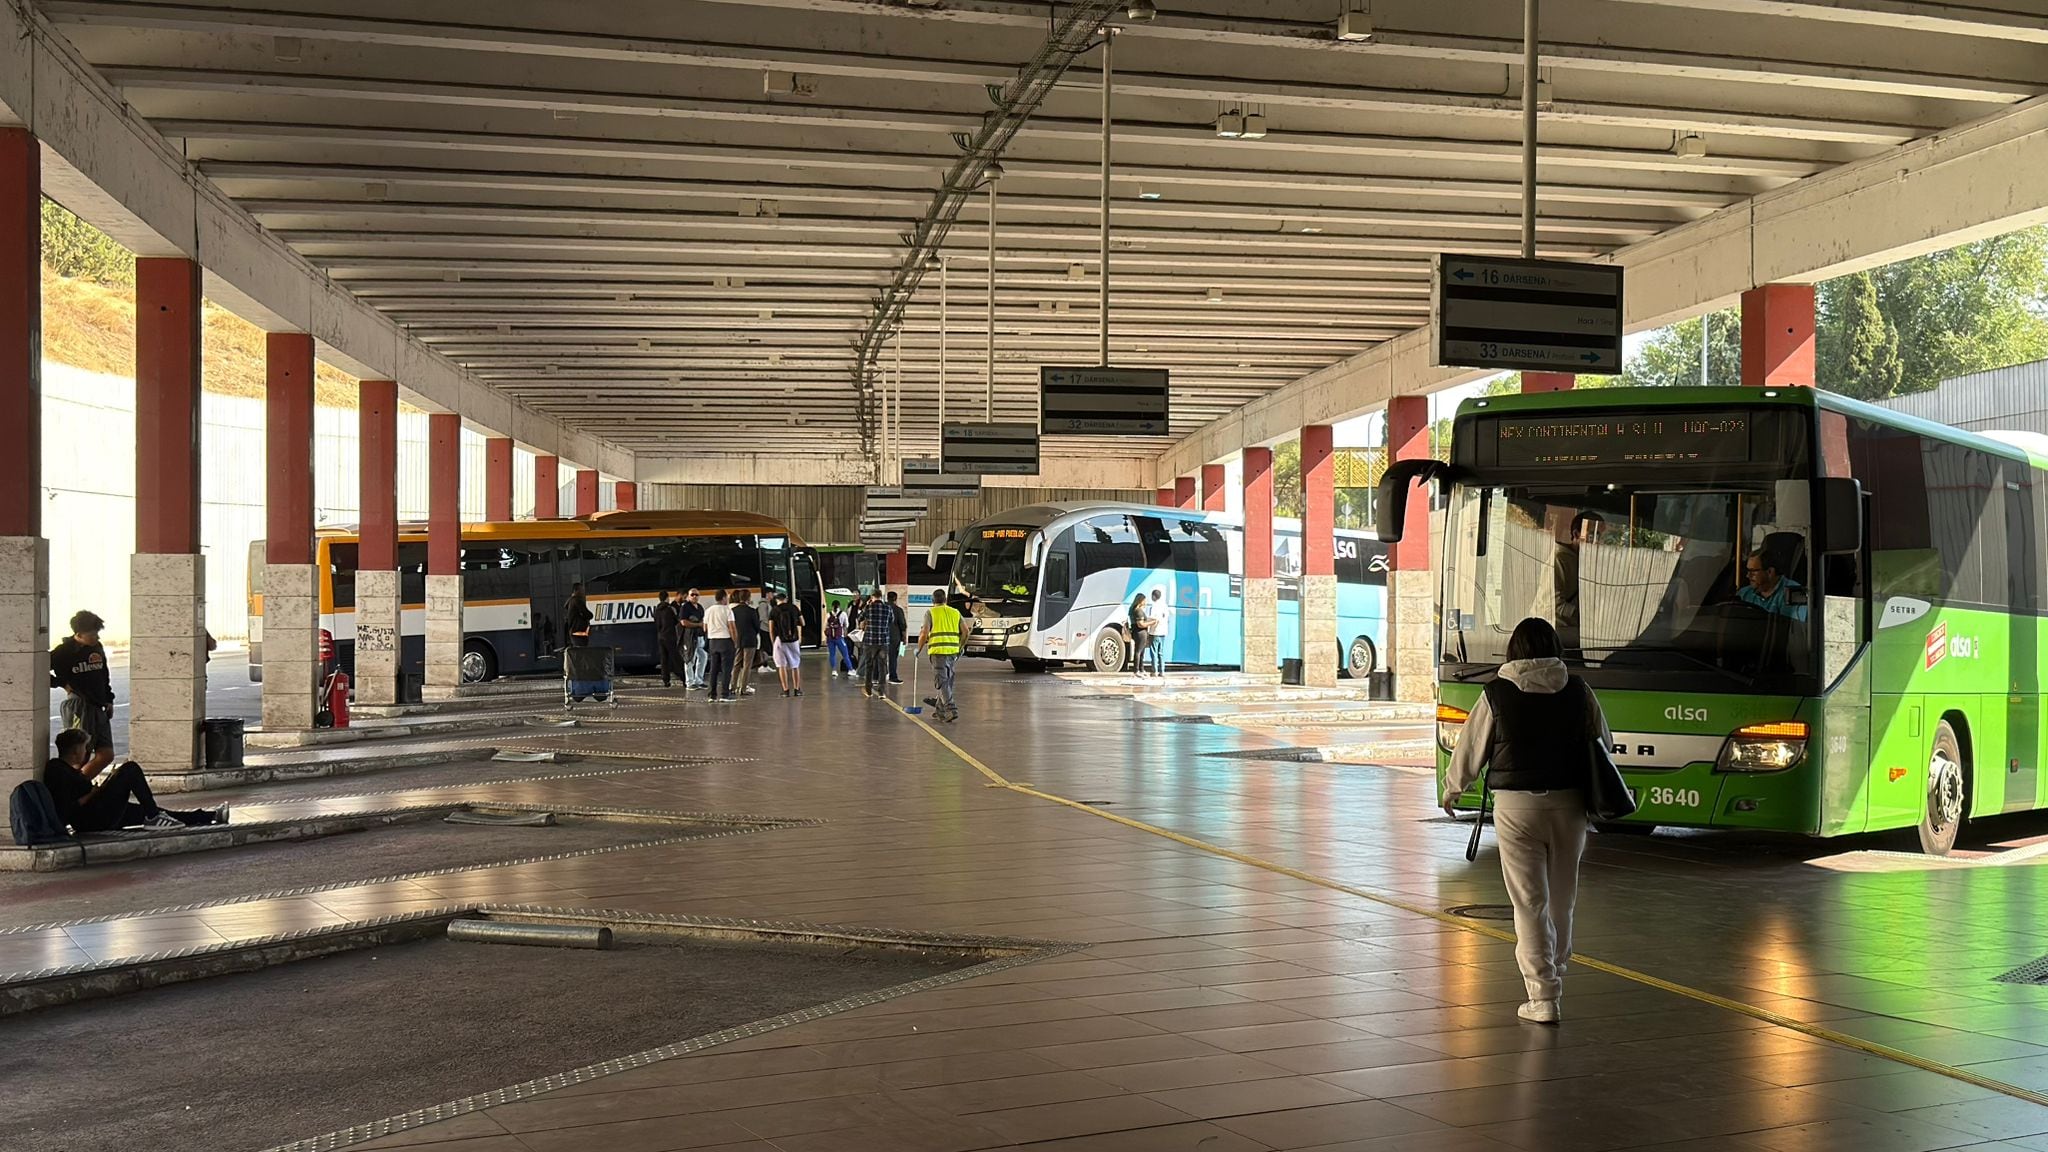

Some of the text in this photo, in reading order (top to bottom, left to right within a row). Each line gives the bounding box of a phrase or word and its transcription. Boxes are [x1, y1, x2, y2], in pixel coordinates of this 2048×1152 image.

[1482, 269, 1499, 284] 16
[1479, 343, 1498, 358] 33
[1070, 374, 1082, 384] 17
[1068, 420, 1082, 429] 32
[1333, 538, 1356, 559] lsa
[1664, 704, 1707, 722] alsa
[1650, 786, 1700, 807] 3640
